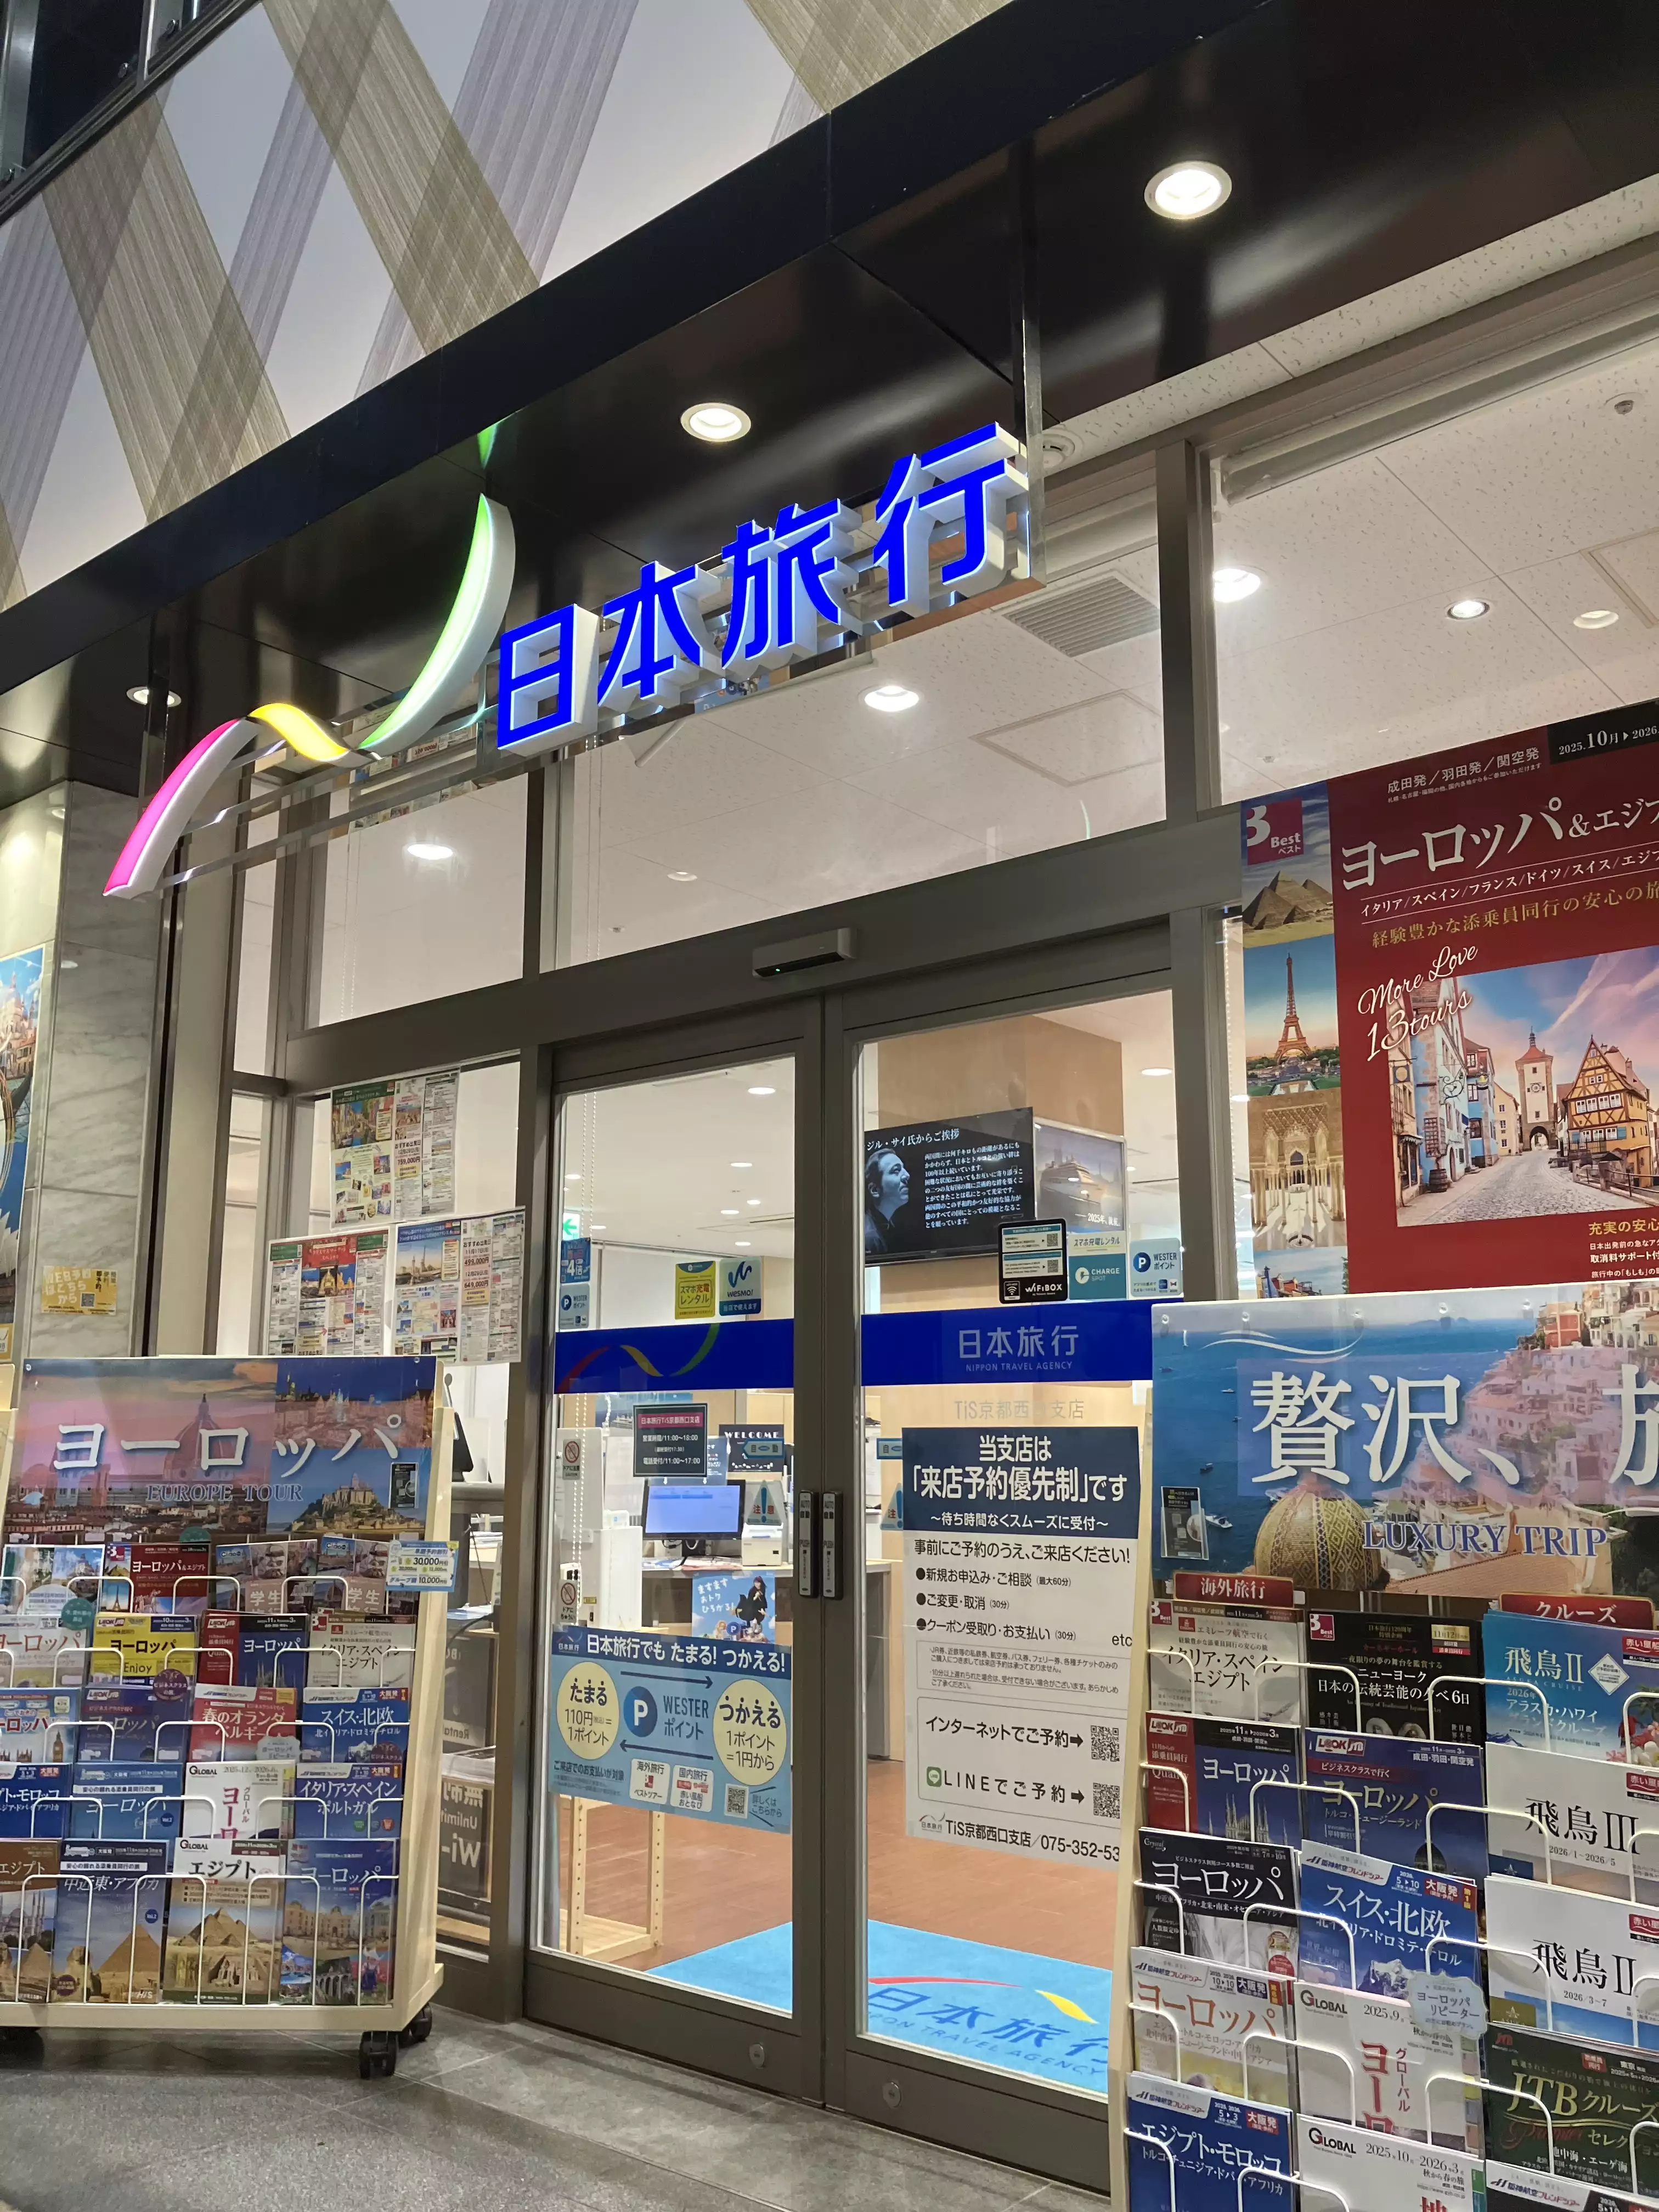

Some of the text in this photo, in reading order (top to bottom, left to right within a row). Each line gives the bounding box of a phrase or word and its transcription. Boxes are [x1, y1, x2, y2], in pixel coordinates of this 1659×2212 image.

[498, 421, 1011, 752] 日本旅行
[1270, 832, 1302, 850] Best
[1278, 843, 1302, 855] ベスト
[1357, 945, 1479, 1015] More Love
[1073, 1237, 1120, 1248] スマホ充電レンタル
[1153, 1252, 1177, 1262] WESTER
[1153, 1262, 1175, 1270] ポイント
[1091, 1267, 1120, 1276] CHARGE
[680, 1283, 710, 1294] スマホ充電
[680, 1294, 710, 1305] レンタル
[958, 1324, 1079, 1359] 日本旅行
[965, 1361, 1073, 1372] NIPPON TRAVEL AGENCY
[724, 1431, 780, 1439] WELCOME
[53, 1414, 402, 1479] ヨーロッパ
[978, 1434, 1052, 1462] 当支店は
[912, 1464, 1128, 1503] 「来店予約優先制」です
[146, 1483, 304, 1503] EUROPE TOUR
[1362, 1520, 1608, 1558] LUXURY TRIP
[697, 1578, 728, 1594] ますます
[1200, 1577, 1266, 1600] 海外旅行
[250, 1590, 281, 1606] 学生
[347, 1587, 380, 1606] 学生
[701, 1593, 721, 1604] おトク
[1536, 1601, 1618, 1624] クルーズ
[110, 1638, 177, 1654] ヨーロッパ
[244, 1637, 301, 1653] ヨーロッパ
[558, 1643, 580, 1652] 日本旅行
[1111, 1634, 1132, 1647] etc
[587, 1634, 785, 1672] 日本旅行でも たまる! つかえる!
[1162, 1646, 1283, 1674] イタリア・スペイン
[123, 1663, 153, 1674] Enjoy
[336, 1657, 379, 1669] エジプト
[1189, 1671, 1250, 1692] エジプト
[1357, 1668, 1427, 1684] ニューヨーク
[570, 1678, 608, 1706] たまる
[663, 1695, 709, 1719] WESTER
[719, 1695, 781, 1729] つかえる
[321, 1707, 394, 1726] スイス・北欧
[568, 1726, 609, 1746] 1ポイント
[664, 1719, 704, 1740] ポイント
[926, 1716, 1069, 1748] インターネットでご予約
[727, 1731, 775, 1751] 1ポイント
[1317, 1738, 1347, 1752] LOOK
[189, 1765, 217, 1775] GLOBAL
[636, 1760, 665, 1775] 海外旅行
[679, 1768, 708, 1782] 国内旅行
[1203, 1757, 1289, 1784] ヨーロッパ
[1321, 1762, 1390, 1778] ビジネスクラスで行く
[300, 1780, 397, 1798] イタリア・スペイン
[634, 1789, 663, 1799] ベストツアー
[944, 1770, 1065, 1804] LINEでご予約
[679, 1799, 702, 1809] おとなび
[752, 1794, 777, 1806] 詳しくは
[1322, 1780, 1438, 1815] ヨーロッパ
[752, 1805, 783, 1818] こちらから
[180, 1839, 208, 1850] GLOBAL
[188, 1859, 257, 1880] エジプト
[1152, 1860, 1284, 1901] ヨーロッパ
[1426, 1878, 1458, 1898] 大阪発
[1323, 1883, 1451, 1939] スイス・北欧
[1238, 1979, 1267, 1994] 大阪発
[1137, 1980, 1277, 2037] ヨーロッパ
[1300, 1989, 1348, 2015] GLOBAL
[1417, 1992, 1471, 2007] ヨーロッパ
[1431, 2004, 1480, 2018] リピーター
[921, 2025, 1105, 2075] TRAVEL AGENCY
[1396, 2047, 1410, 2112] グローバル
[1247, 2112, 1278, 2129] 大阪発
[1141, 2122, 1282, 2174] エジプト・モロッコ
[1308, 2126, 1357, 2155] GLOBAL
